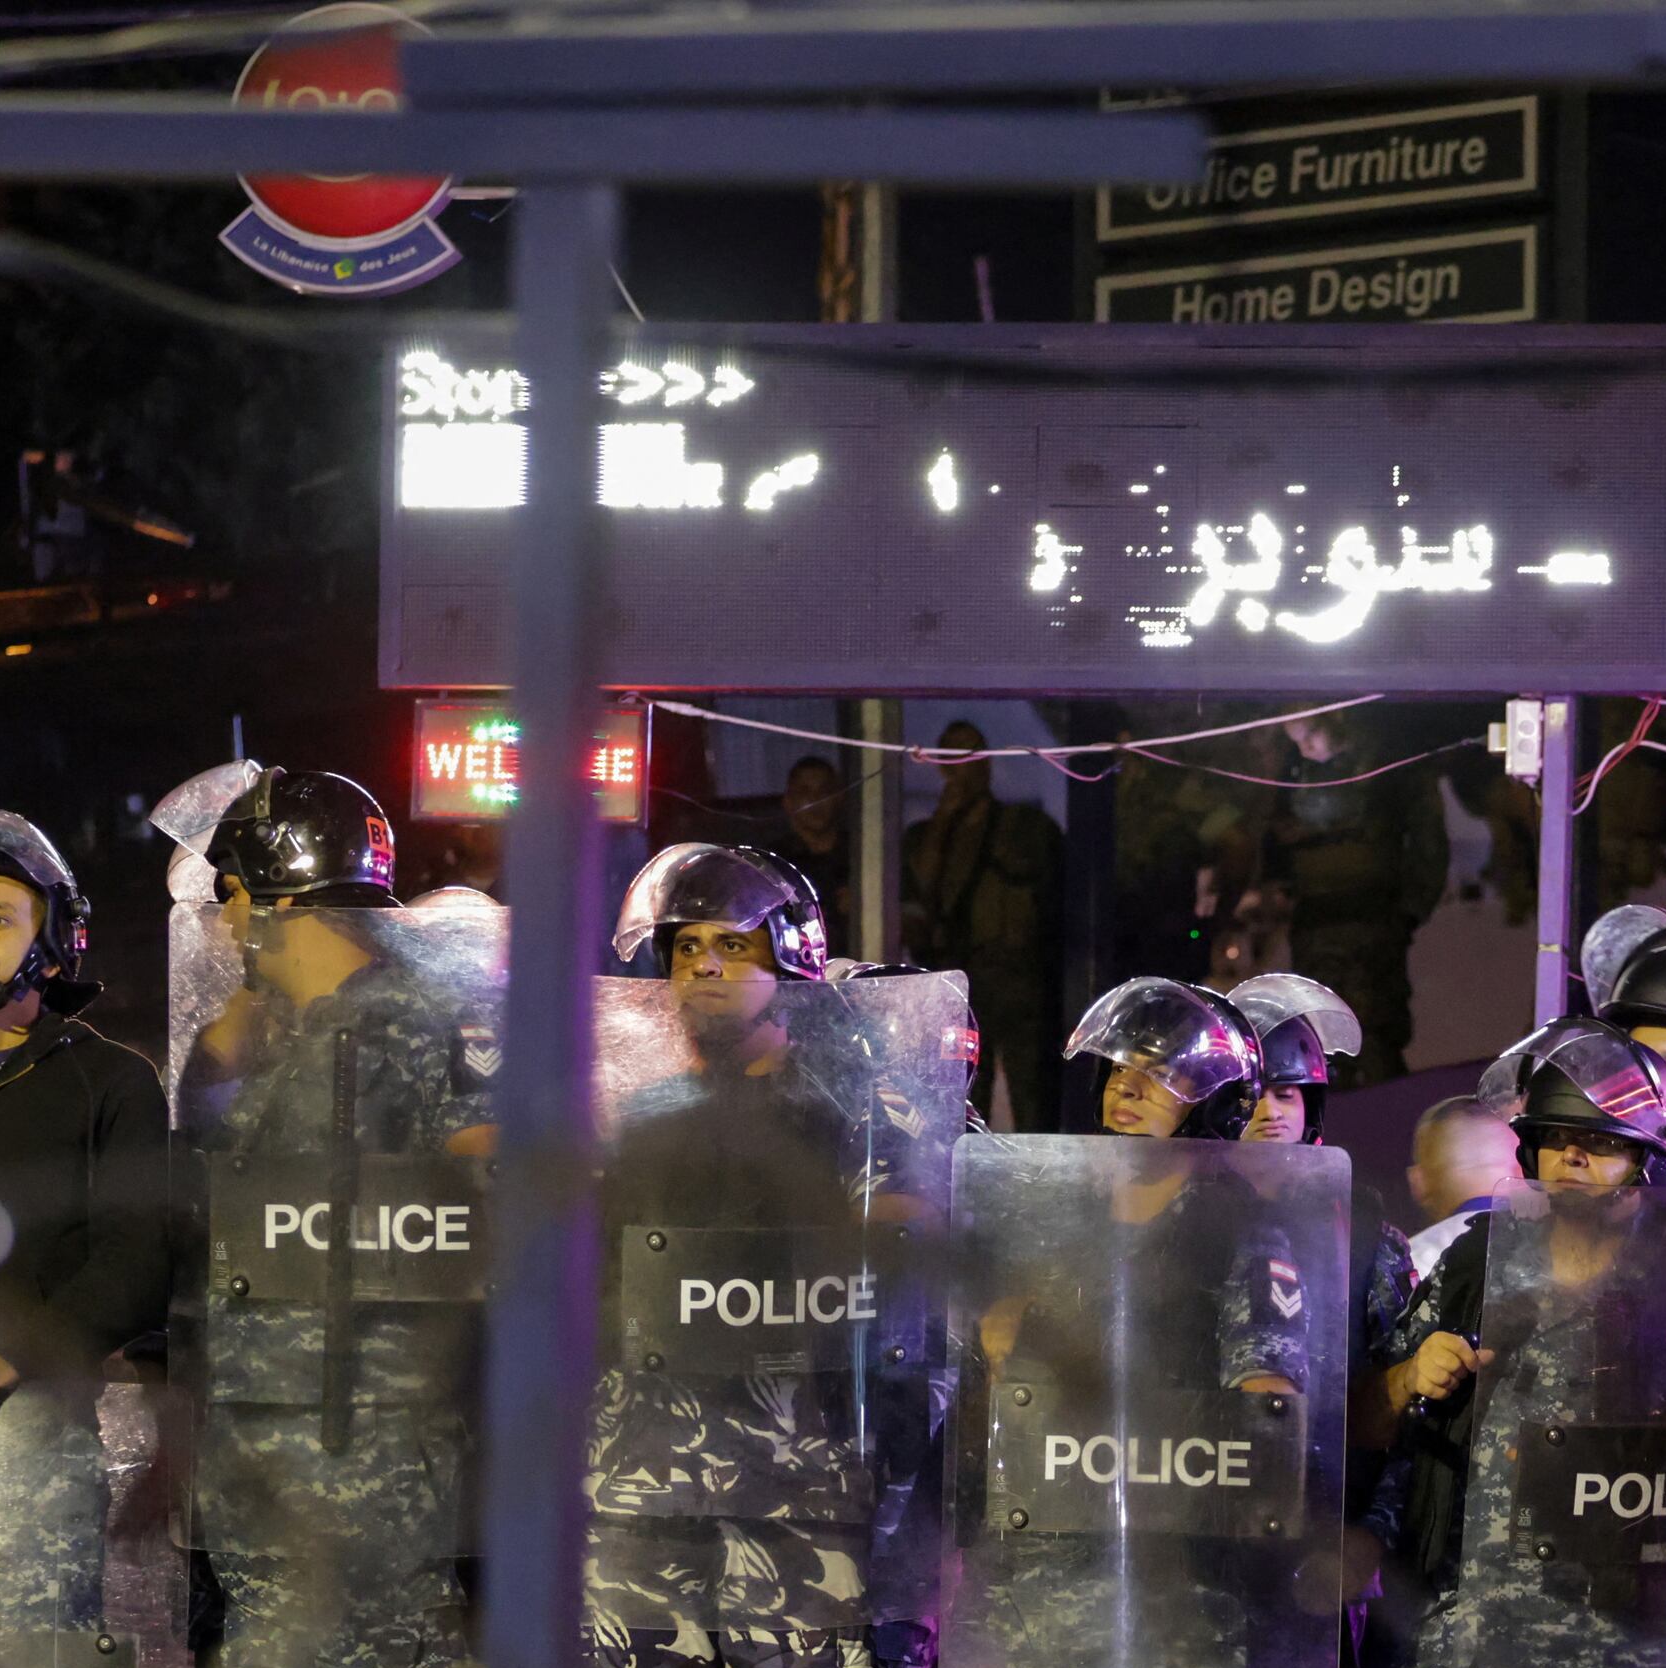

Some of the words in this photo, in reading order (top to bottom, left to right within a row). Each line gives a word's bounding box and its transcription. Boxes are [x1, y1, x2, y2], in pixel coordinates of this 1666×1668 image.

[1289, 134, 1489, 195] Furniture
[270, 246, 330, 273] Libanaise
[359, 259, 384, 273] des
[1172, 283, 1295, 323] Home
[1307, 258, 1461, 318] Design
[426, 742, 635, 783] WELE
[265, 1202, 471, 1253] POLICE
[679, 1273, 878, 1327] POLICE
[1043, 1434, 1252, 1487] POLICE
